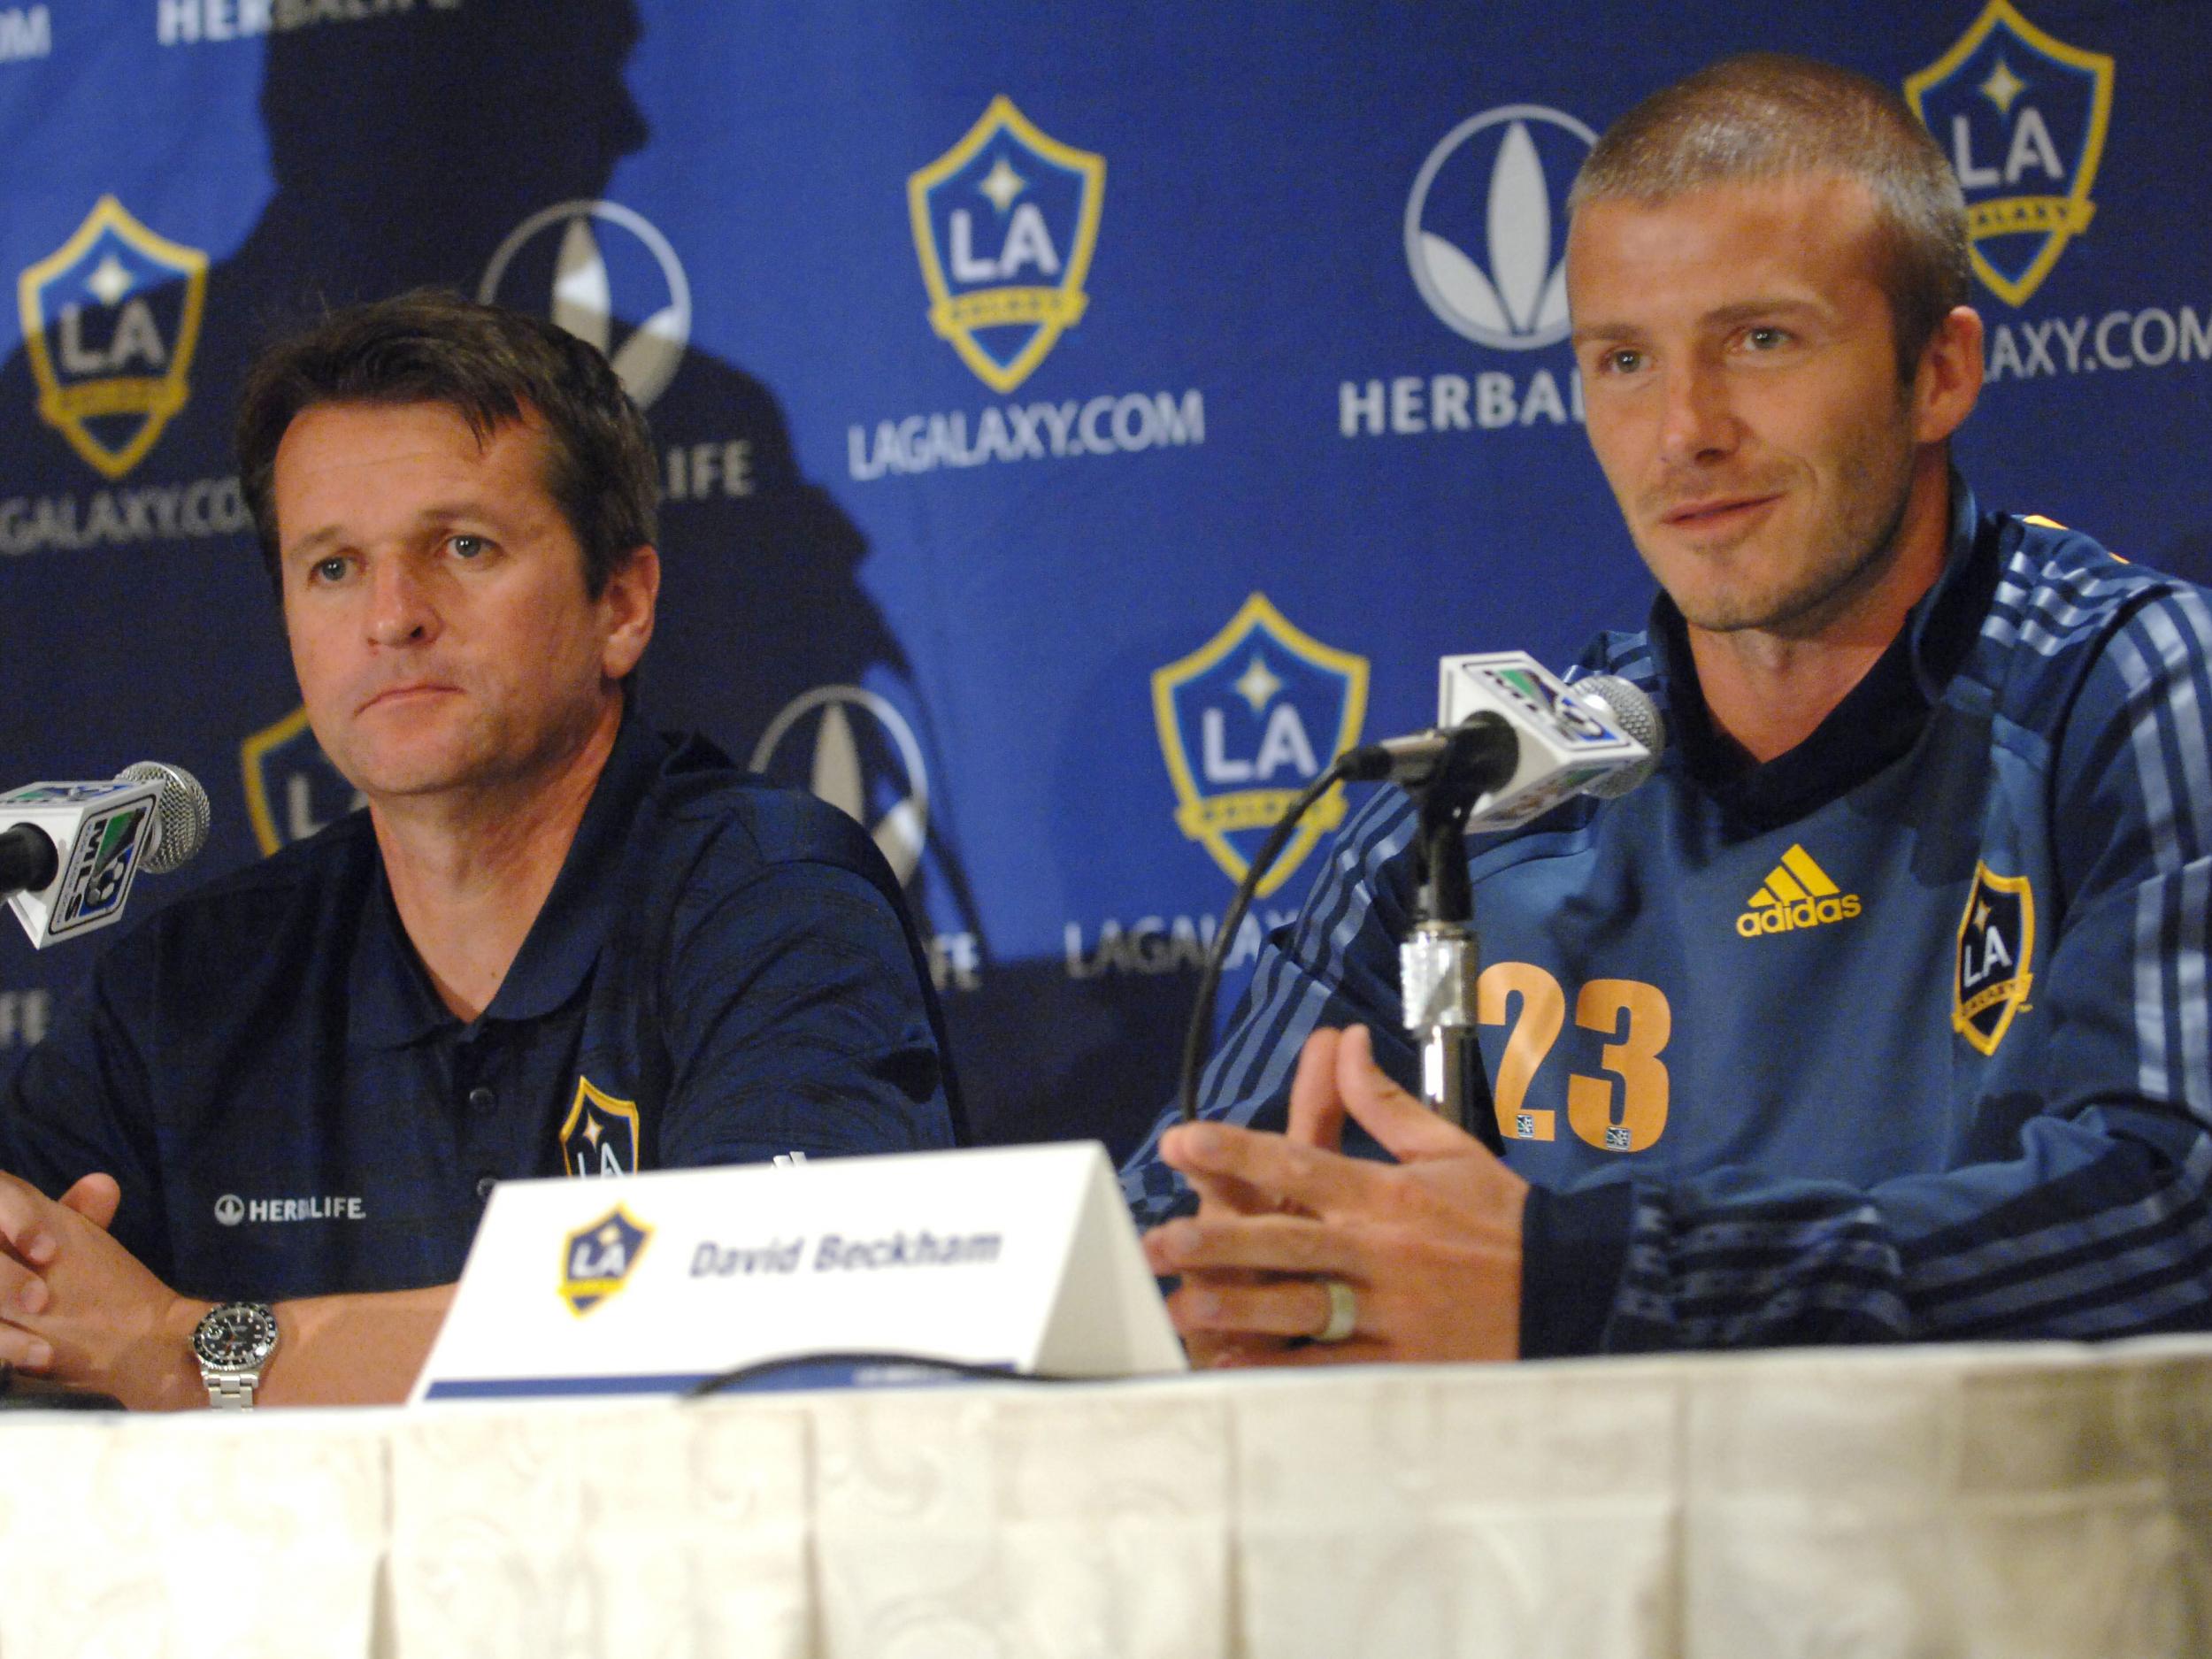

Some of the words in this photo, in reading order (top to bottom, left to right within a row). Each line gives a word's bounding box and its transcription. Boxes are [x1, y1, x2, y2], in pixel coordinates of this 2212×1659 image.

[1951, 107, 2065, 188] LA
[950, 204, 1060, 283] LA
[59, 299, 165, 374] LA
[1983, 305, 2212, 384] AXY.COM
[659, 440, 755, 501] IFE
[848, 388, 1206, 482] LAGALAXY.COM
[1202, 703, 1318, 782] LA
[288, 765, 370, 840] L
[1735, 893, 1863, 938] adidas
[1963, 925, 2013, 988] LA
[1477, 961, 1672, 1153] 23
[689, 1236, 805, 1279] David
[812, 1227, 1003, 1272] Beckham
